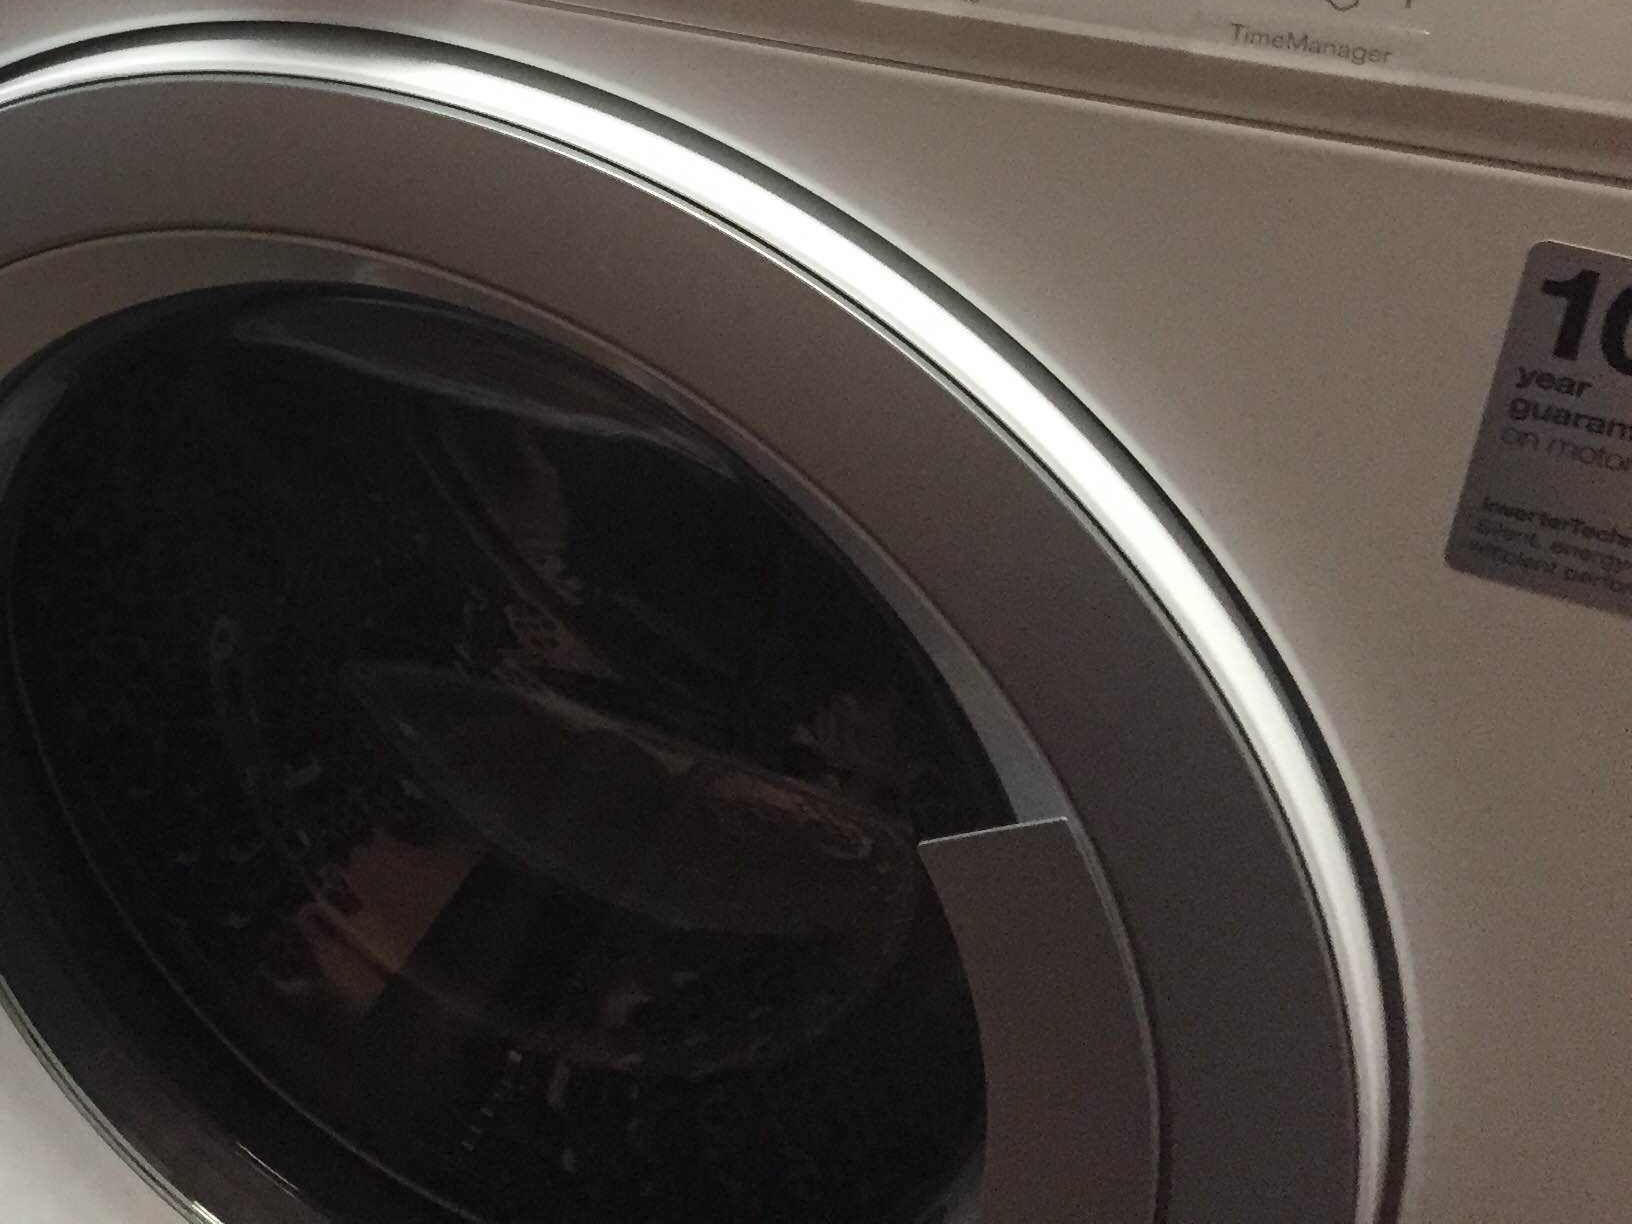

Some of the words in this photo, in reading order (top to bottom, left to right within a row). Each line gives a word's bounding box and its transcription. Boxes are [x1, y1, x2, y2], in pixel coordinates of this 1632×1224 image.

[1231, 23, 1393, 65] TimeManager
[1516, 366, 1592, 398] year
[1501, 426, 1540, 451] on
